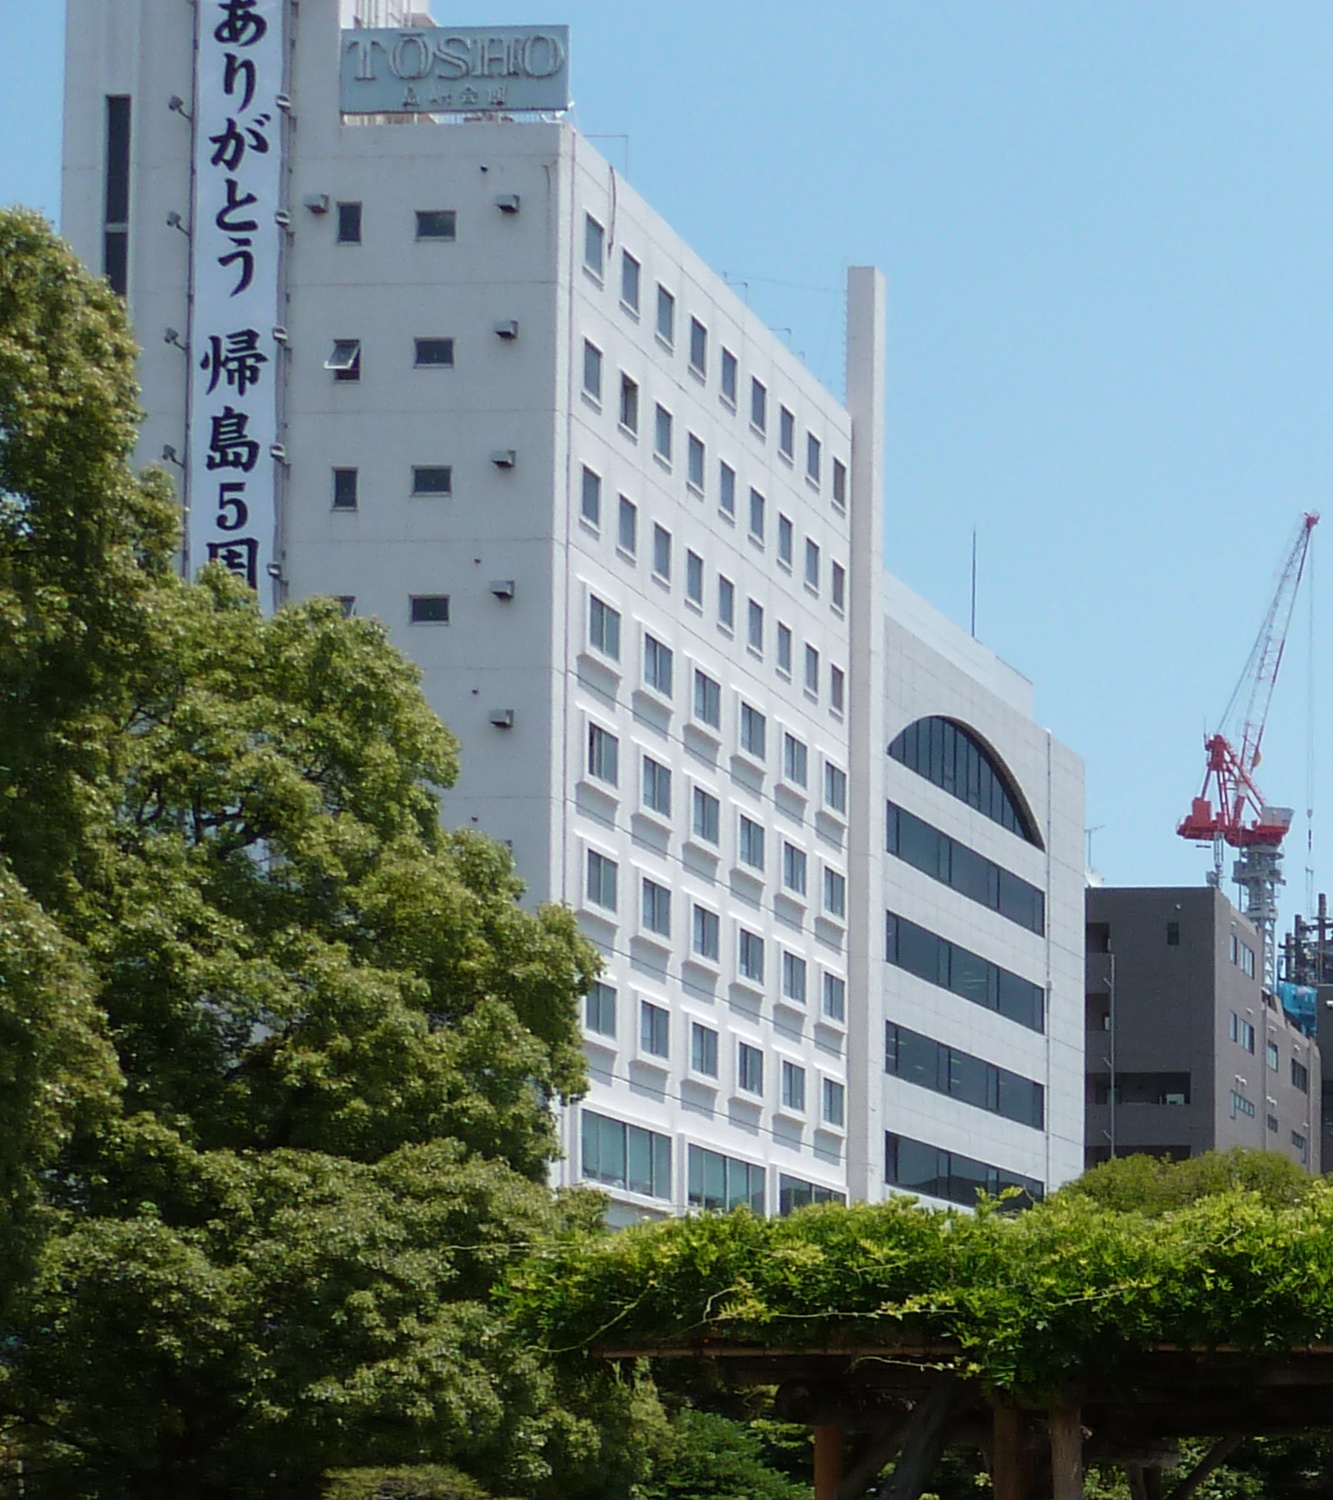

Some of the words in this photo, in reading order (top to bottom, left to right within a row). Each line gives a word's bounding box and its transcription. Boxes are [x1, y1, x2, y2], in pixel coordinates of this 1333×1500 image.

[208, 0, 271, 298] ありがとう
